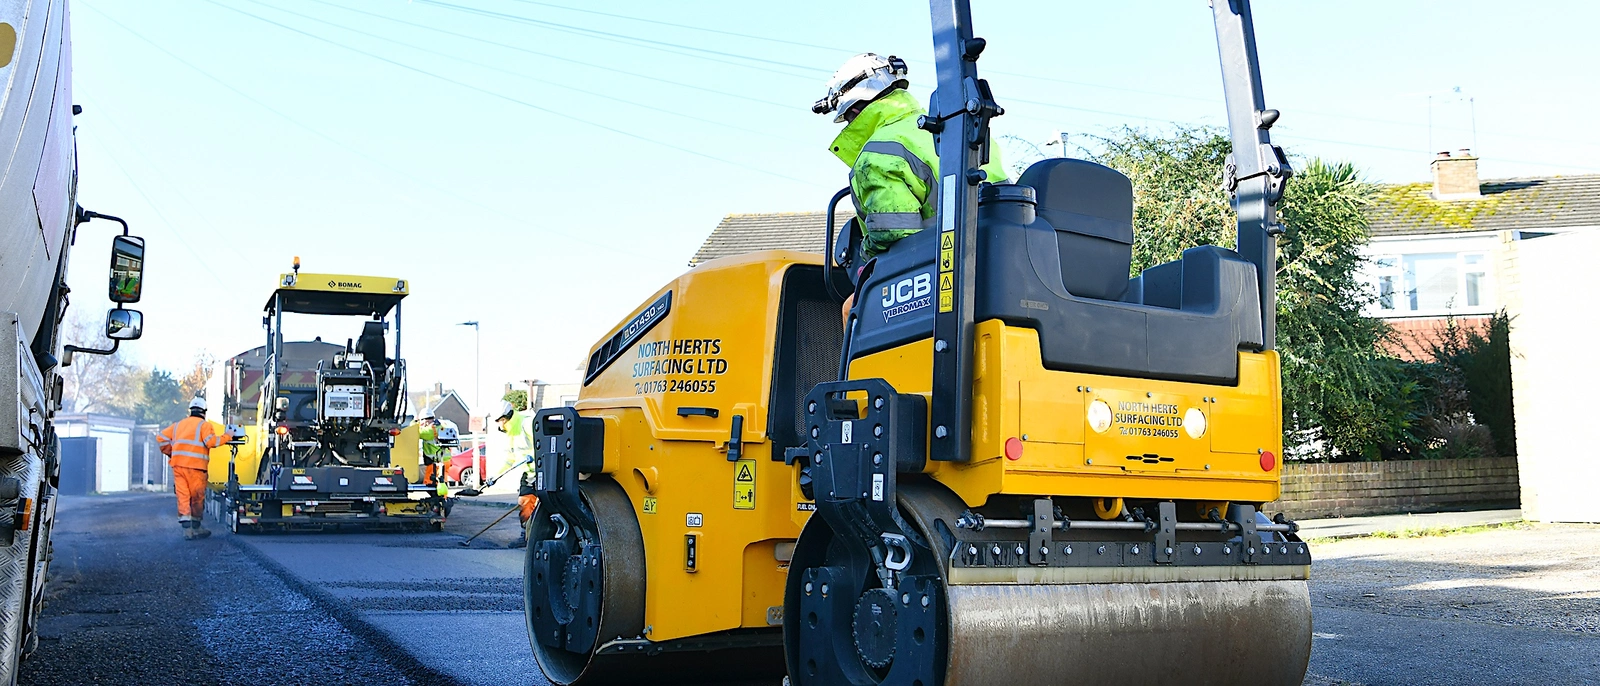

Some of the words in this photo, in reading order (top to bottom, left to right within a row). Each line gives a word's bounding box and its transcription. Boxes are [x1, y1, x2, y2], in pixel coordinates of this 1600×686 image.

[882, 272, 931, 308] JCB
[883, 297, 930, 323] VIBROMAX
[629, 306, 656, 335] CT430
[637, 340, 670, 359] NORTH
[672, 339, 721, 355] HERTS
[632, 358, 694, 378] SURFACING
[697, 359, 728, 374] LTD
[643, 381, 667, 394] 01763
[669, 380, 716, 393] 246055
[1118, 401, 1149, 412] NORTH
[1151, 404, 1178, 414] HERTS
[1115, 413, 1165, 426] SURFACING
[1167, 416, 1183, 427] LTD
[1129, 428, 1151, 437] 01763
[1153, 429, 1179, 438] 246055
